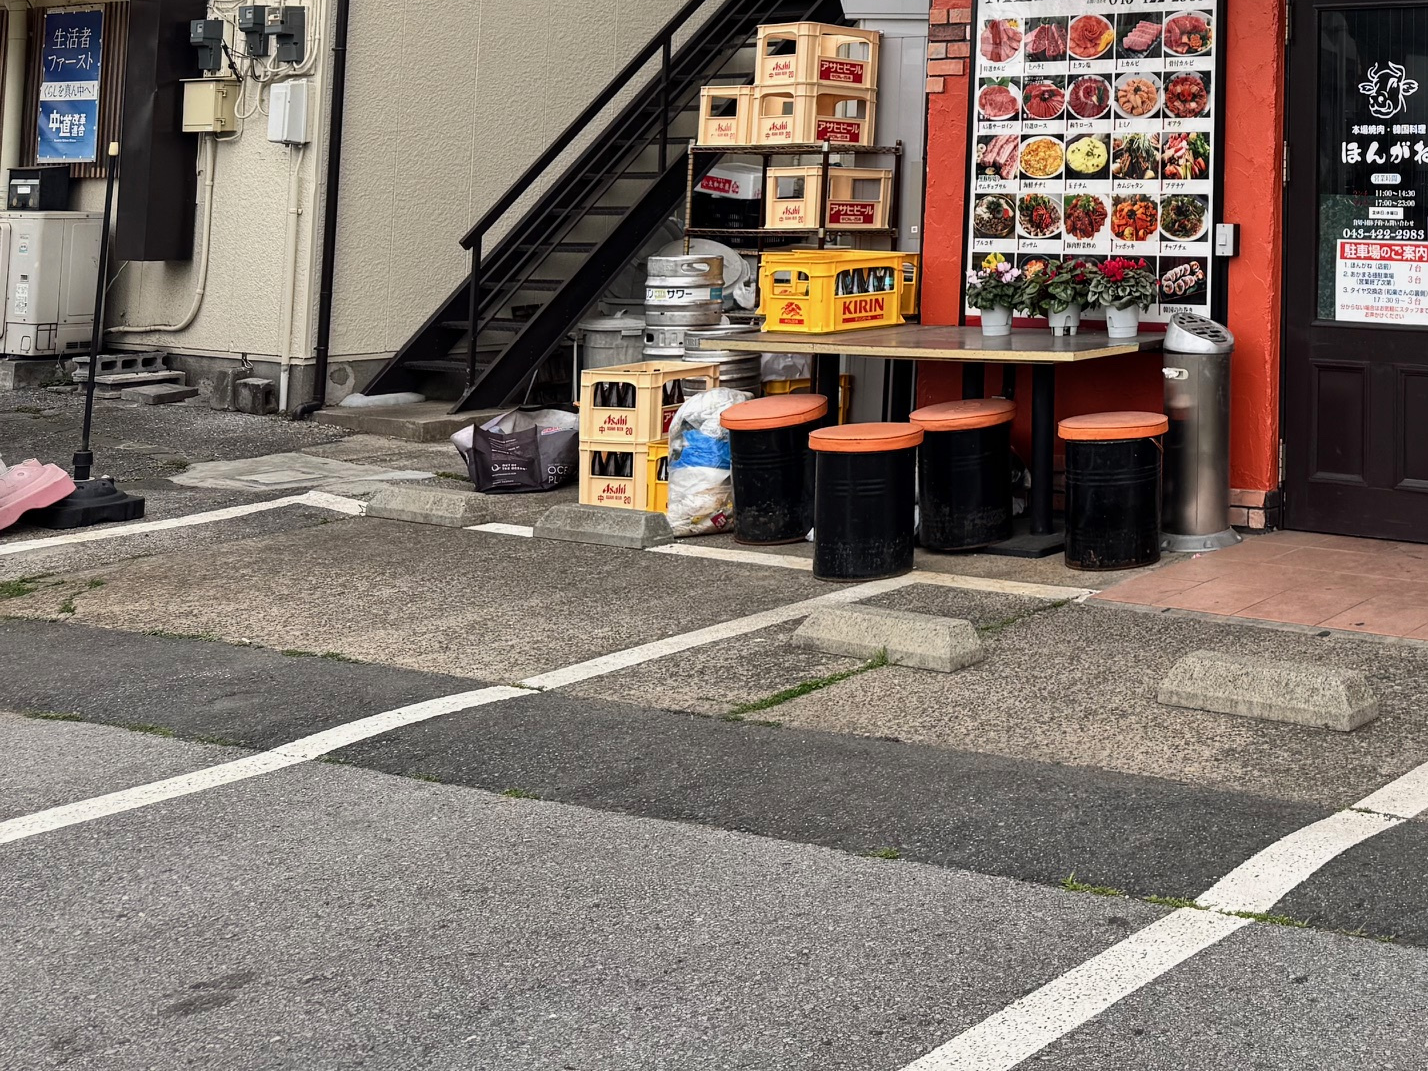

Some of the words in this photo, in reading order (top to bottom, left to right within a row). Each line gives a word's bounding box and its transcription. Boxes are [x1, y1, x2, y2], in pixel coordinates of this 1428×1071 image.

[52, 27, 92, 49] 生活者
[48, 51, 94, 73] ファースト
[772, 60, 791, 71] Asahi
[821, 61, 863, 74] アサヒビール
[48, 109, 73, 137] 中道
[769, 120, 788, 131] Asahi
[818, 122, 860, 134] アサヒビール
[782, 205, 801, 215] Asahi
[830, 204, 874, 215] アサヒビール
[1342, 228, 1425, 240] 043-422-2983
[1343, 243, 1428, 261] 駐車場のご案内
[667, 289, 693, 299] サワー
[842, 297, 885, 316] KIRIN
[603, 414, 628, 426] Asahi
[602, 483, 627, 494] Asahi
